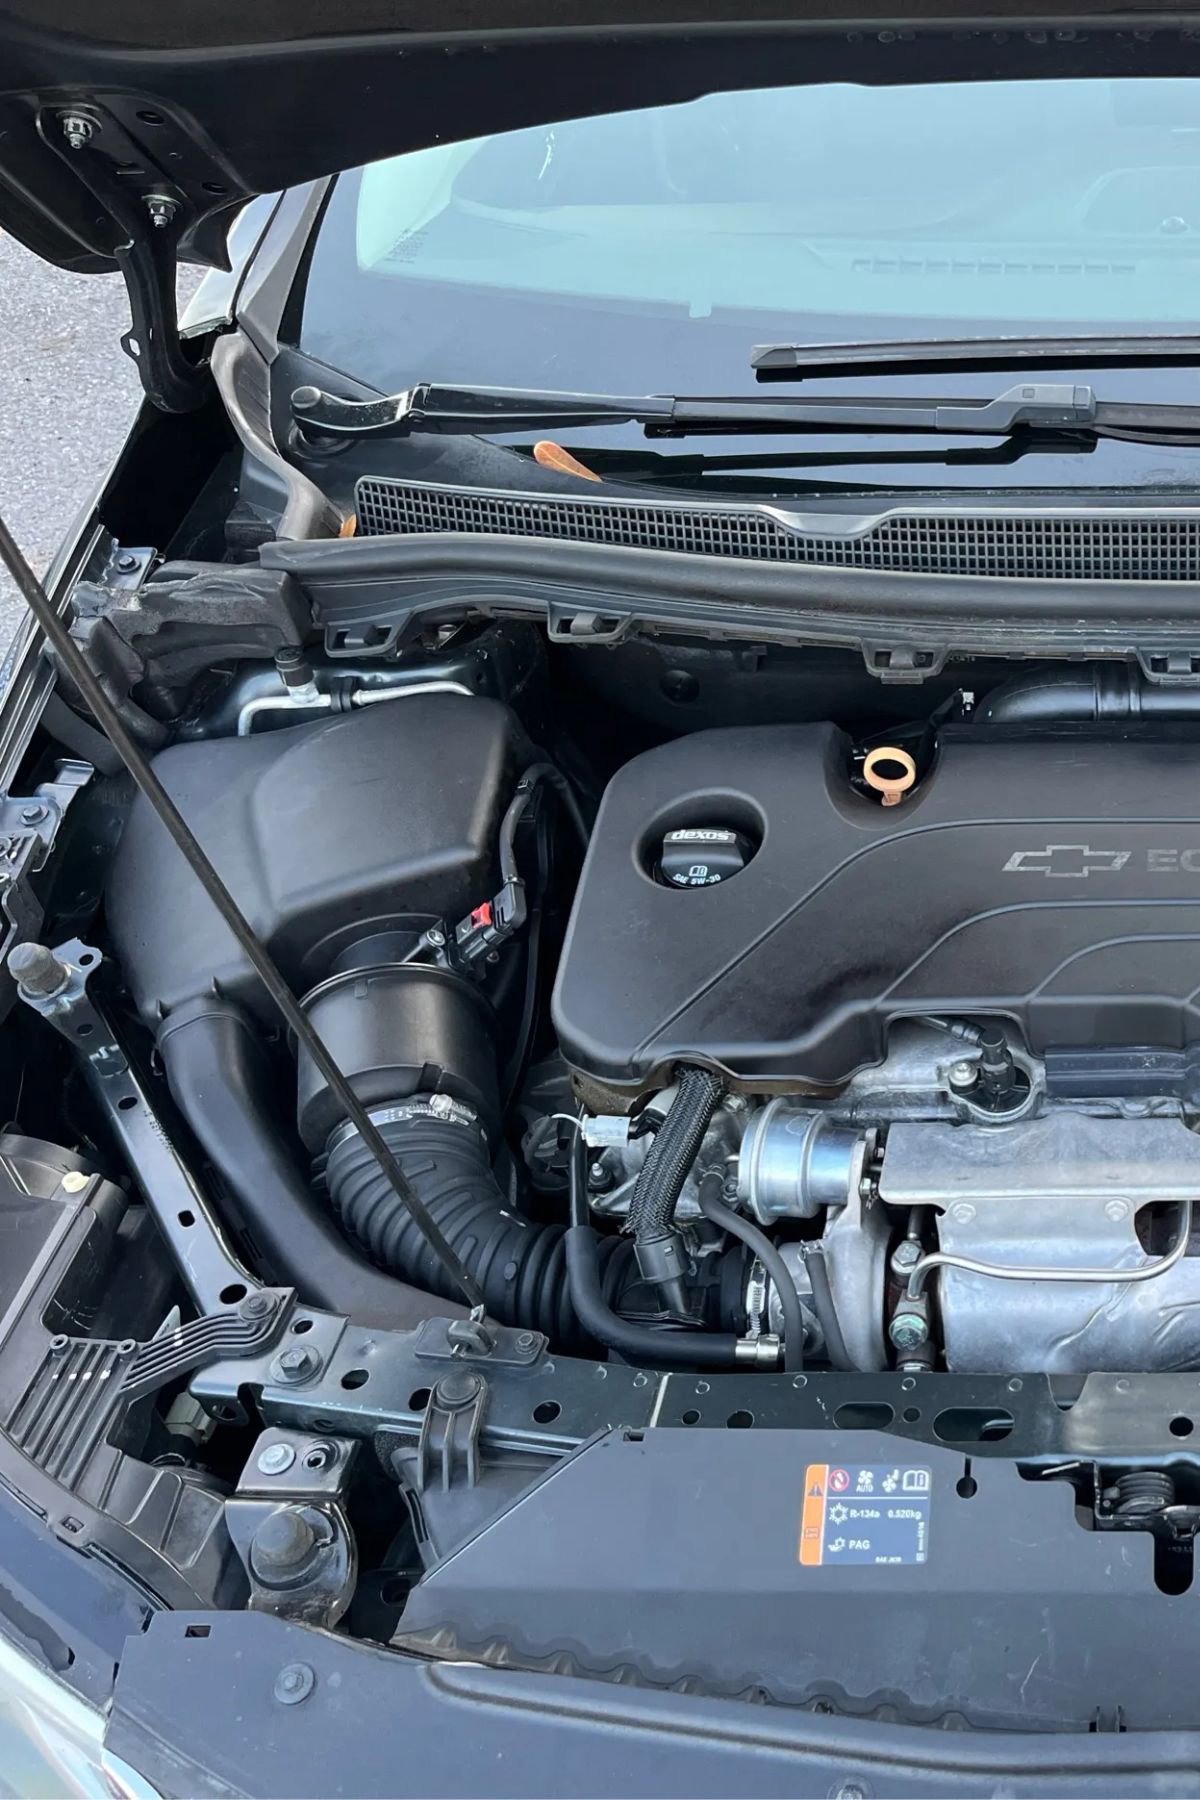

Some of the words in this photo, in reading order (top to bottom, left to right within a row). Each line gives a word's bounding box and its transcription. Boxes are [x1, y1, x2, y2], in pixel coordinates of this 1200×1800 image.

[671, 829, 730, 841] dexos
[856, 1484, 874, 1493] AUTO
[849, 1509, 881, 1519] R-134a
[848, 1539, 871, 1550] PAG
